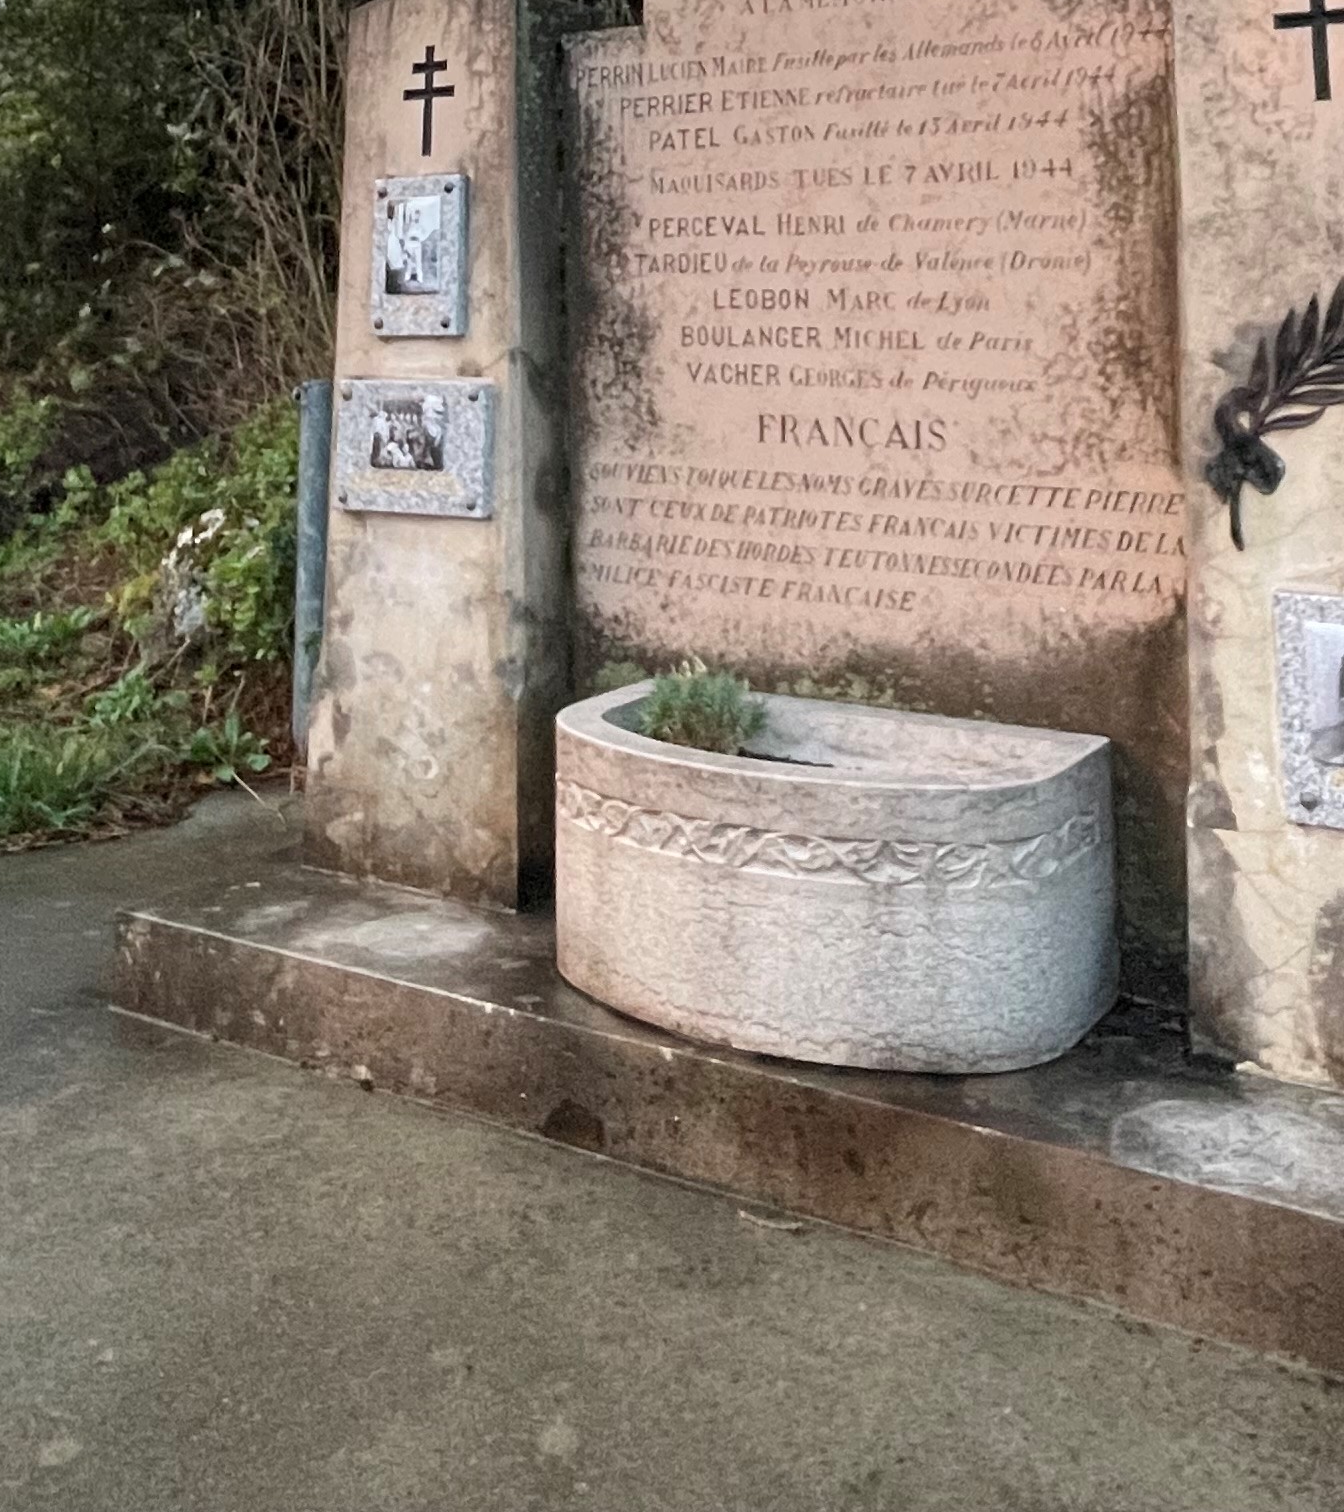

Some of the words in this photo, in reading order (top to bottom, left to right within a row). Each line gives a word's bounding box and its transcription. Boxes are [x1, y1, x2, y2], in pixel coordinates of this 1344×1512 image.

[576, 63, 643, 88] PERRIN
[649, 59, 707, 84] LUCIEN
[712, 55, 768, 77] MAIRE
[834, 52, 870, 70] par
[873, 43, 897, 63] les
[902, 34, 1004, 61] Allemands
[1011, 32, 1027, 50] le
[1045, 23, 1106, 50] Avril
[620, 91, 713, 118] PERRIER
[722, 87, 810, 112] ETIENNE
[971, 76, 989, 93] le
[992, 72, 1005, 92] 7
[1007, 68, 1061, 89] Avril
[1065, 65, 1116, 88] 1944
[649, 127, 720, 151] PATEL
[734, 125, 815, 146] GASTON
[897, 119, 913, 137] le
[945, 113, 1001, 135] Avril
[1008, 109, 1068, 131] 1944
[650, 169, 779, 194] MAQUISARDS
[863, 165, 892, 186] LE
[905, 165, 917, 184] 7
[923, 160, 999, 184] AVRIL
[1013, 157, 1072, 179] 1944
[649, 215, 766, 239] PERCEVAL
[777, 213, 845, 236] HENRI
[857, 214, 880, 233] de
[889, 212, 992, 236] Chamery
[996, 207, 1087, 233] (Marne)
[634, 252, 728, 275] TARDIEU
[732, 256, 753, 273] de
[759, 255, 778, 273] la
[881, 252, 903, 272] de
[915, 250, 995, 272] Valence
[713, 288, 809, 311] LEOBON
[827, 288, 896, 311] MARC
[906, 291, 931, 309] de
[936, 291, 990, 316] Lyon
[681, 325, 821, 348] BOULANGER
[833, 326, 926, 350] MICHEL
[936, 331, 962, 351] de
[968, 331, 1034, 351] Paris
[686, 362, 781, 387] VACHER
[789, 364, 883, 388] GEORGES
[889, 370, 914, 389] de
[589, 462, 682, 485] SOUVIENS
[686, 465, 718, 487] TOI
[718, 468, 757, 490] QUE
[758, 471, 796, 491] LES
[796, 473, 854, 496] NOMS
[944, 480, 992, 504] SUR
[994, 484, 1081, 508] CETTE
[1084, 488, 1185, 515] PIERRE
[591, 496, 643, 518] SONT
[650, 498, 707, 521] CEUX
[710, 503, 739, 524] DE
[743, 505, 863, 532] PATRIOTES
[989, 522, 1113, 549] VICTIMES
[1116, 530, 1152, 553] DE
[1156, 532, 1186, 556] LA
[589, 529, 693, 558] BARBARIE
[694, 538, 734, 558] DES
[736, 540, 817, 565] HORDES
[824, 547, 950, 575] TEUTONNES
[1079, 567, 1127, 590] PAR
[1133, 571, 1161, 594] LA
[591, 563, 661, 586] MILICE
[668, 569, 775, 598] FASCISTE
